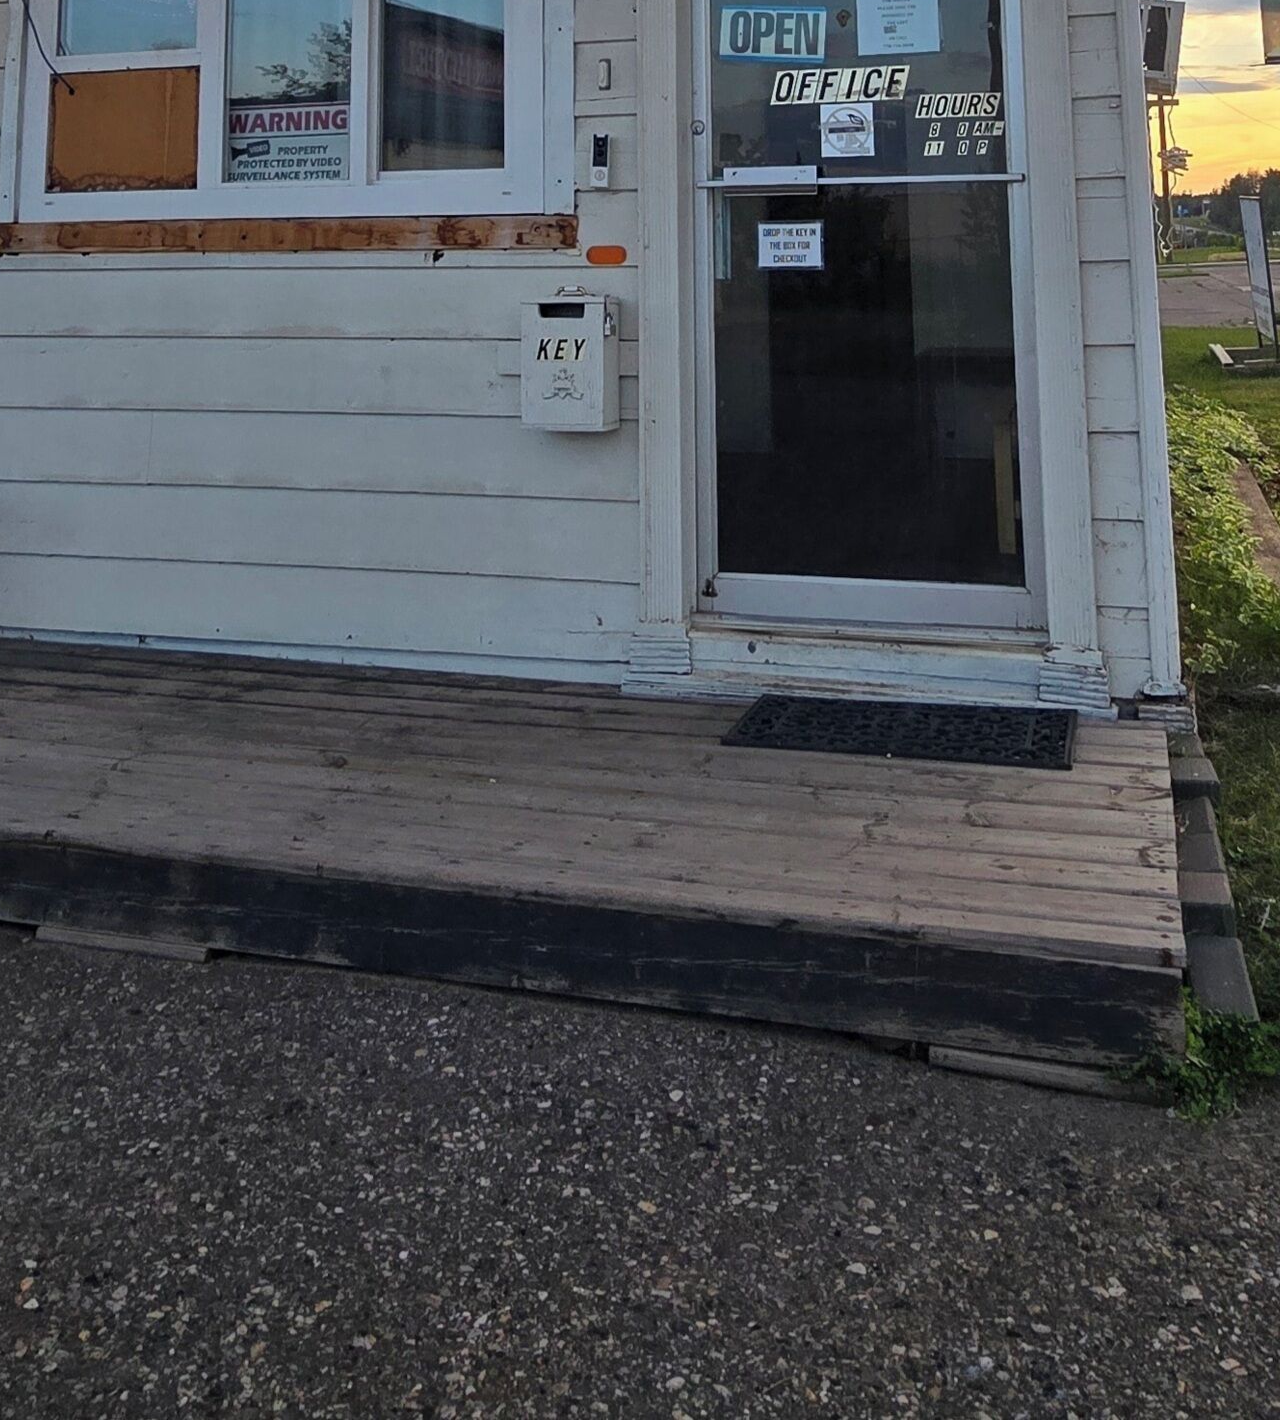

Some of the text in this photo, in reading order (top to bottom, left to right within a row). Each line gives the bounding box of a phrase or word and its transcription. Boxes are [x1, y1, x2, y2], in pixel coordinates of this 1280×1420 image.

[729, 10, 820, 56] OPEN
[775, 68, 998, 117] OFFICE HOURS
[229, 109, 348, 134] WARNING
[930, 123, 939, 136] 8
[249, 144, 269, 153] VIDEO
[277, 145, 329, 156] PROPERTY
[926, 142, 942, 155] 11
[978, 141, 987, 154] P
[237, 157, 342, 169] PROTECTED BY VIDEO
[228, 170, 341, 182] SURVEILLANCE SYSTEM
[782, 228, 794, 237] THE
[795, 228, 808, 237] KEY
[770, 241, 781, 250] THE
[537, 338, 586, 360] KEY
